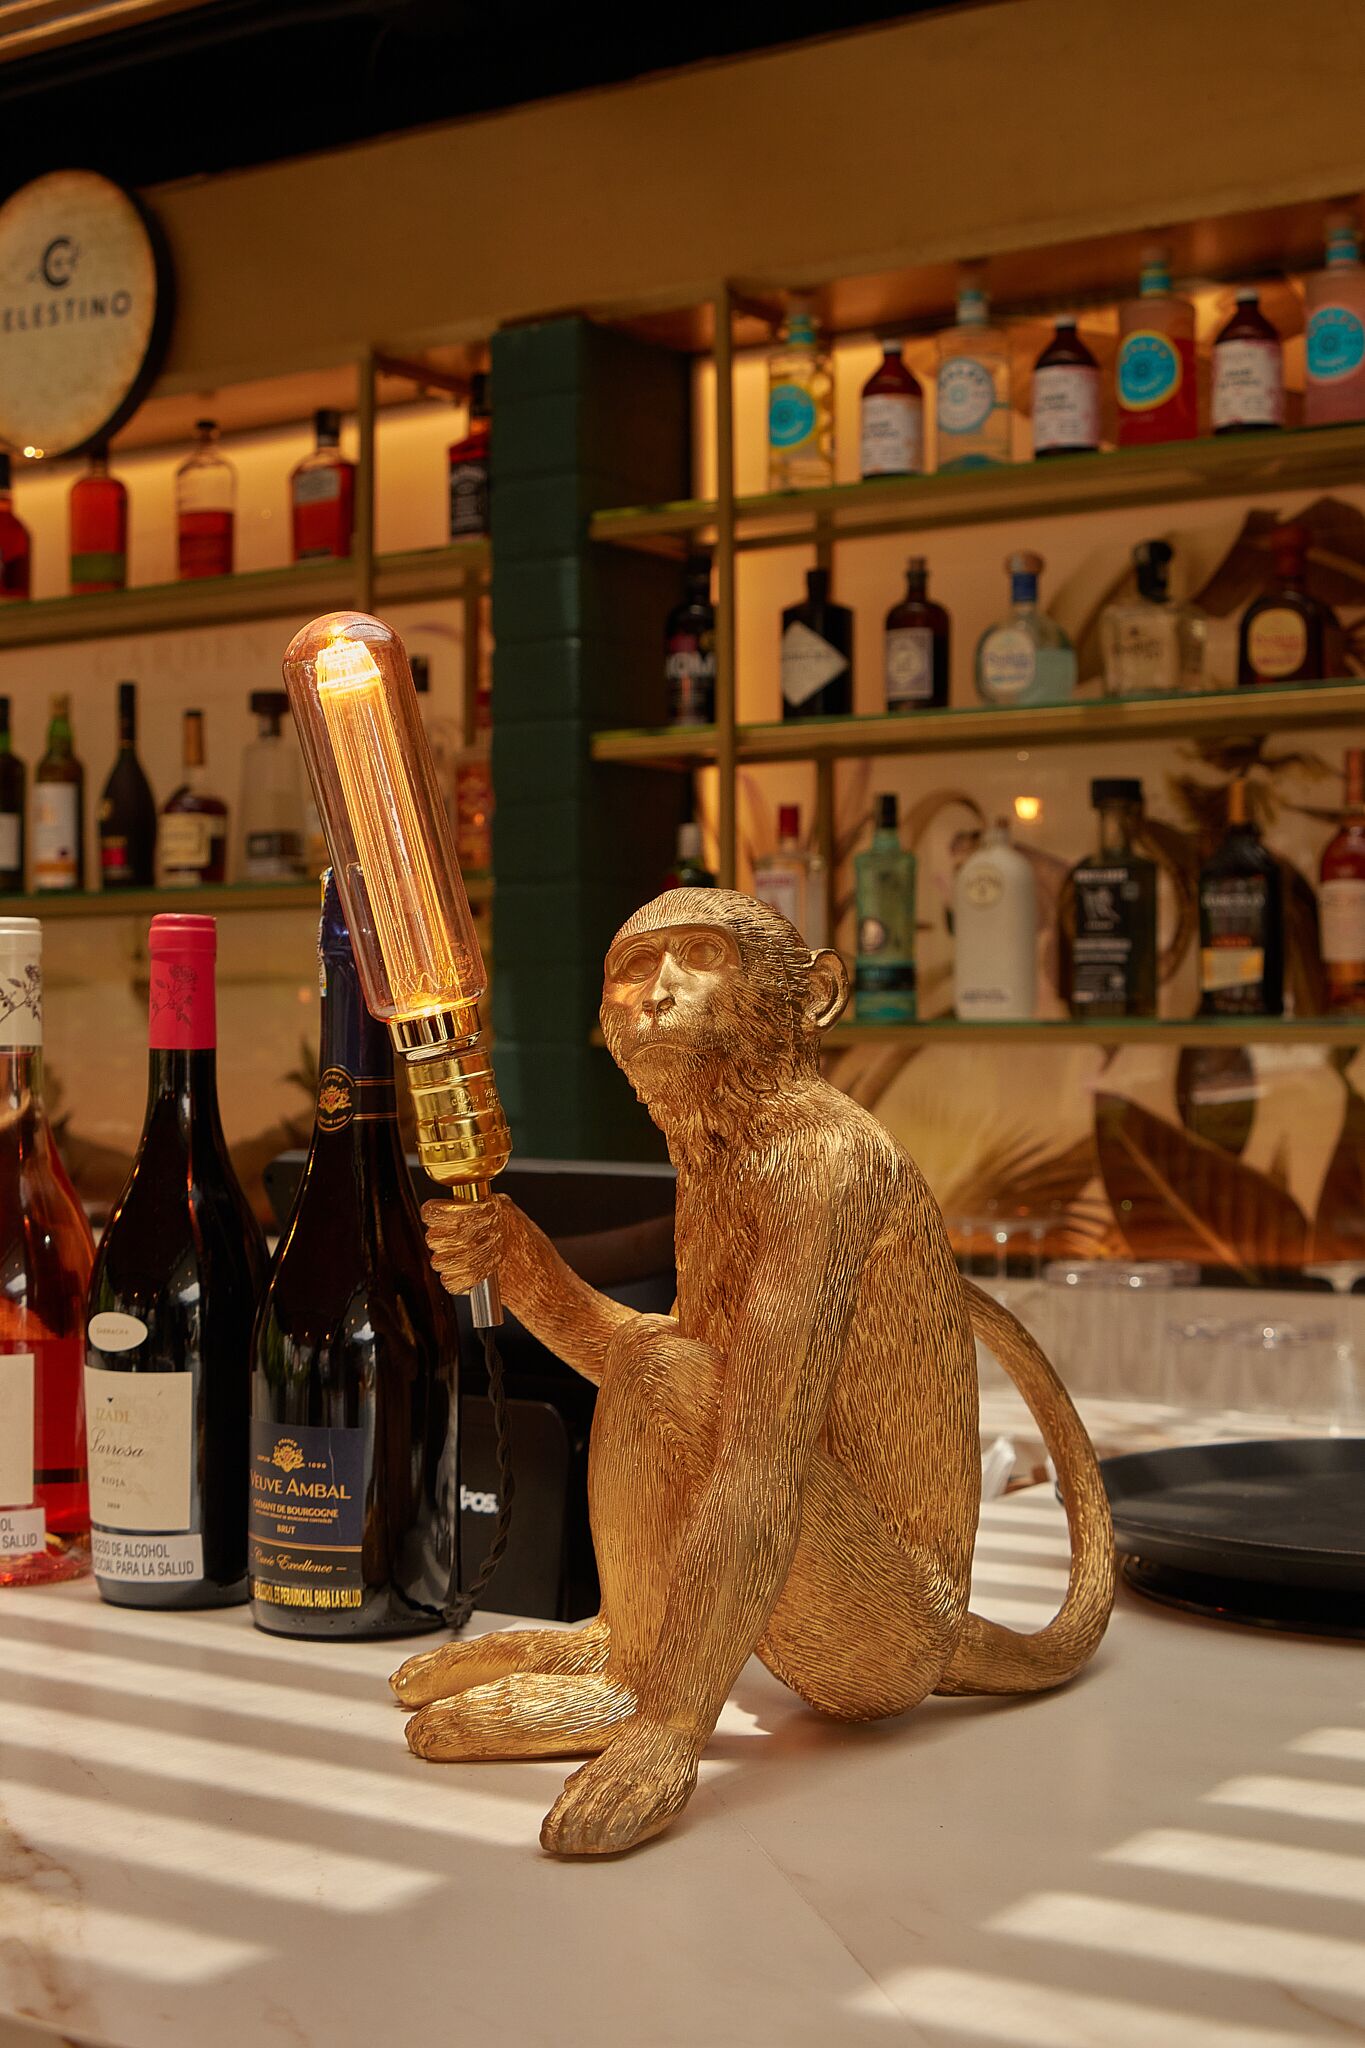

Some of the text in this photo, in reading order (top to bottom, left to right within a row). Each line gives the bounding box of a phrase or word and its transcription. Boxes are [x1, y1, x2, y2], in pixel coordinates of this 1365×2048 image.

[90, 1425, 145, 1457] Larrosa
[285, 1477, 352, 1500] AMBAL
[287, 1505, 339, 1518] BOURGOGNE
[276, 1524, 296, 1535] BRUT
[2, 1533, 37, 1549] SALUD
[111, 1541, 122, 1556] DE
[124, 1543, 170, 1558] ALCOHOL
[116, 1560, 140, 1576] PARA
[142, 1562, 155, 1576] LA
[157, 1560, 194, 1576] SALUD
[276, 1553, 333, 1574] Excellence
[340, 1589, 362, 1608] SALUD
